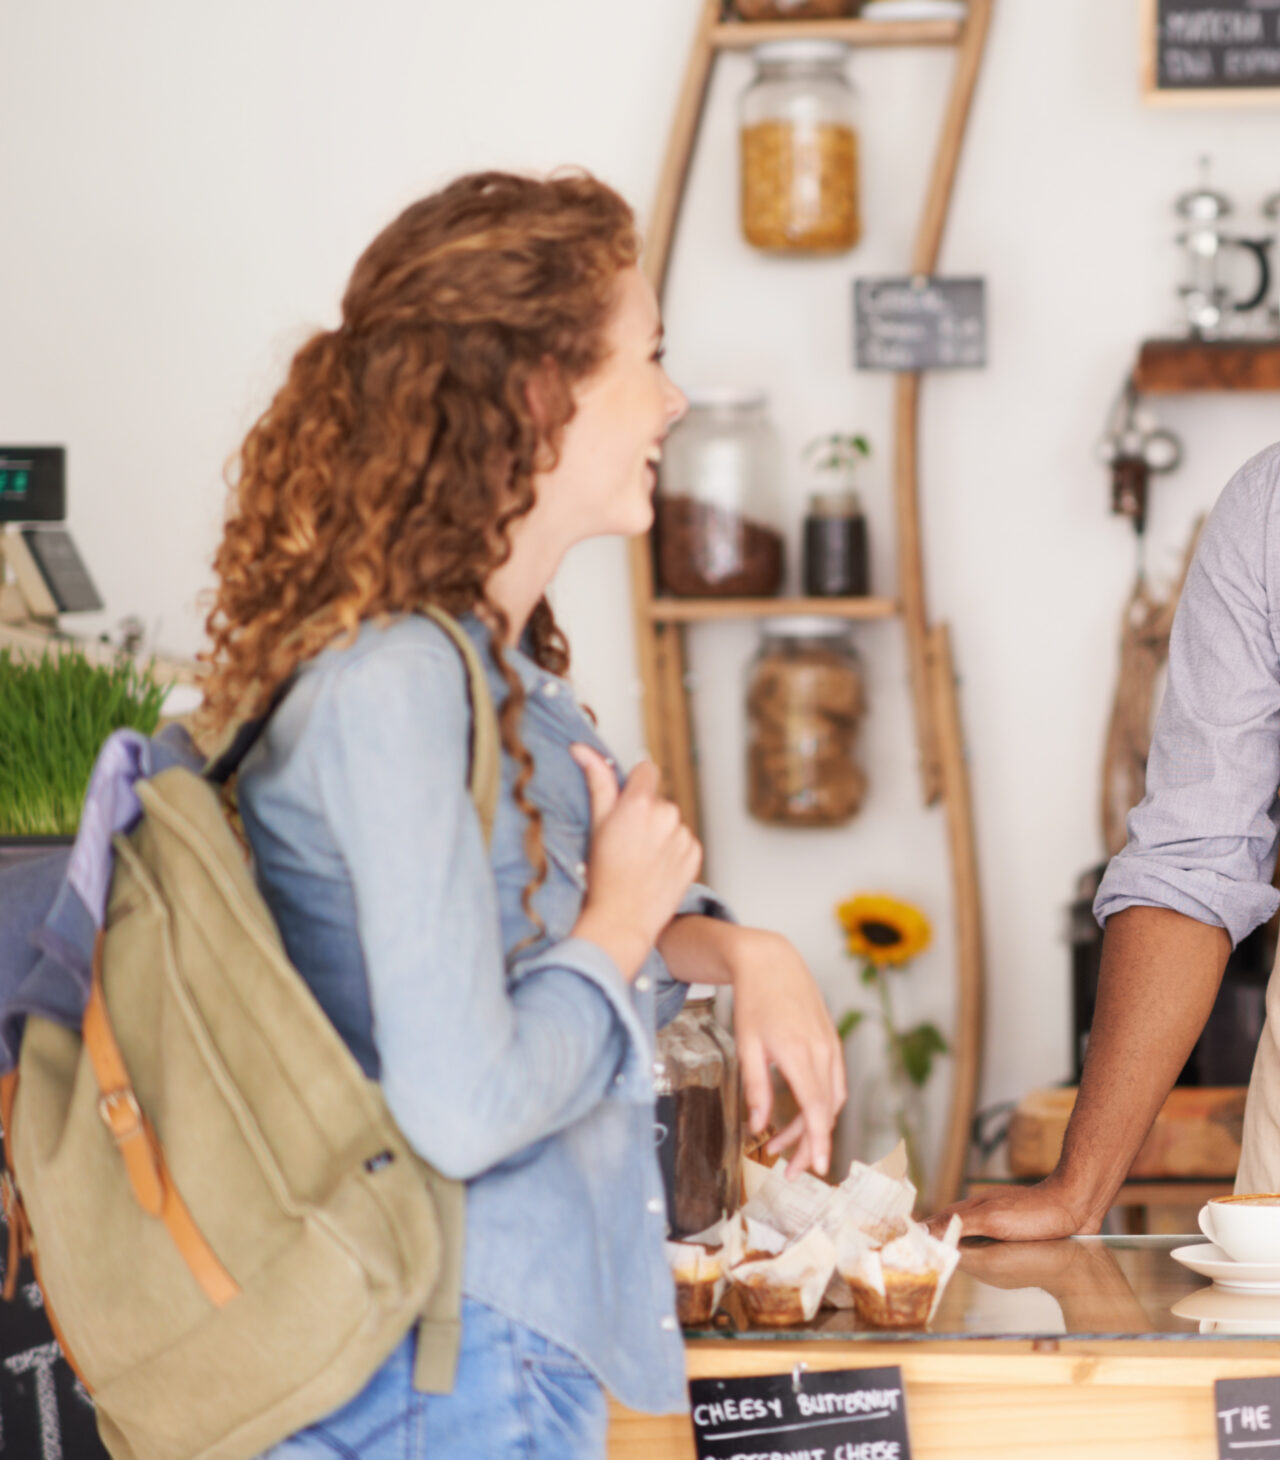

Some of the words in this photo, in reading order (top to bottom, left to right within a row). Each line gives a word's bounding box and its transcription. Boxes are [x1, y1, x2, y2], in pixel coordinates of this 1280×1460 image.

[693, 1397, 783, 1427] CHEESY
[796, 1389, 901, 1416] BUTTERNUT
[1217, 1405, 1272, 1435] THE
